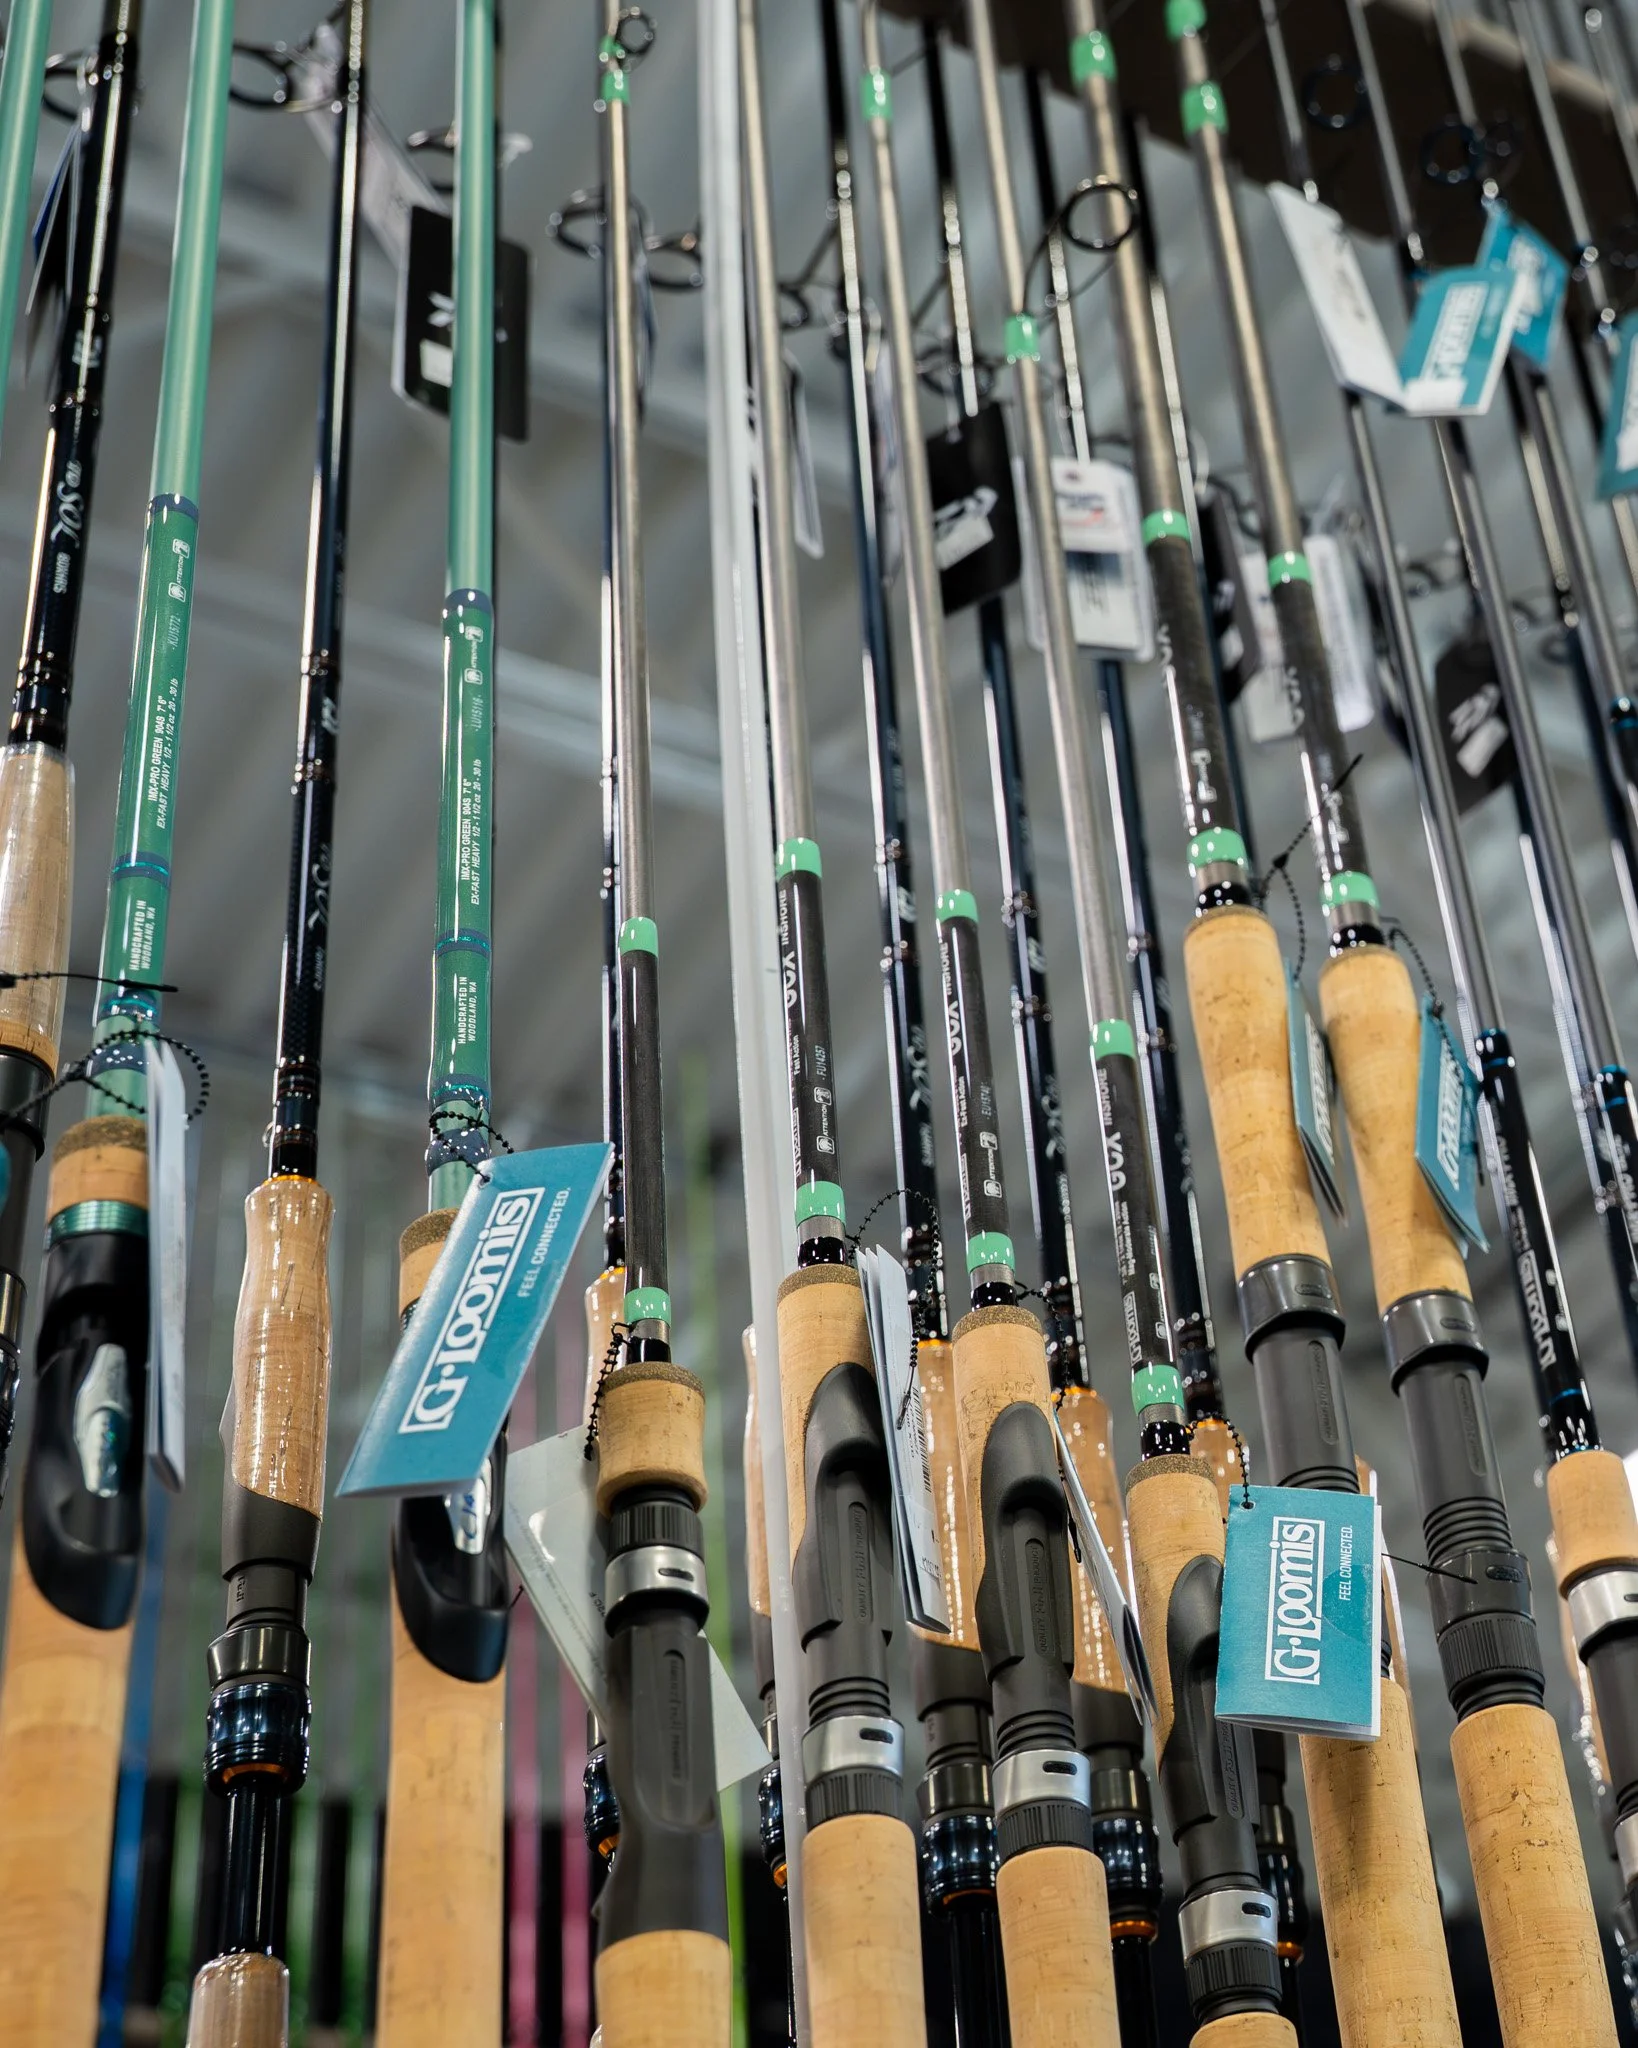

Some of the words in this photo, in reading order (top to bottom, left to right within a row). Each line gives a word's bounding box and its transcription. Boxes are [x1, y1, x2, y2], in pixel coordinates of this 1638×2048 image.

[167, 700, 176, 713] 20
[154, 715, 166, 735] 904S
[165, 723, 175, 736] 1/2
[151, 737, 163, 765] GREEN
[163, 746, 173, 759] 1/2
[147, 767, 160, 803] IMX-PRO
[160, 761, 171, 792] HEAVY
[472, 781, 482, 792] 20
[156, 795, 169, 830] EX-FAST
[462, 797, 472, 816] 904S
[472, 802, 481, 815] 1/2
[461, 818, 471, 845] GREEN
[471, 825, 481, 837] 1/2
[460, 846, 471, 881] IMX-PRO
[471, 840, 481, 868] HEAVY
[470, 870, 480, 906] EX-FAST
[137, 899, 147, 908] IN
[779, 889, 790, 946] INSHORE
[129, 909, 146, 971] HANDCRAFTED
[140, 919, 154, 971] WOODLAND,
[147, 906, 156, 920] WA
[458, 976, 468, 985] IN
[468, 981, 477, 993] WA
[457, 987, 468, 1044] HANDCRAFTED
[468, 995, 478, 1042] WOODLAND,
[792, 1034, 800, 1056] Action
[1097, 1067, 1113, 1126] INSHORE
[820, 1104, 829, 1137] ATTENTION
[1105, 1131, 1127, 1192] GCX
[516, 1262, 540, 1299] FEEL
[529, 1186, 572, 1268] CONNECTED.
[1339, 1523, 1354, 1578] CONNECTED.
[1338, 1577, 1352, 1602] FEEL
[1228, 1776, 1240, 1813] QUALITY
